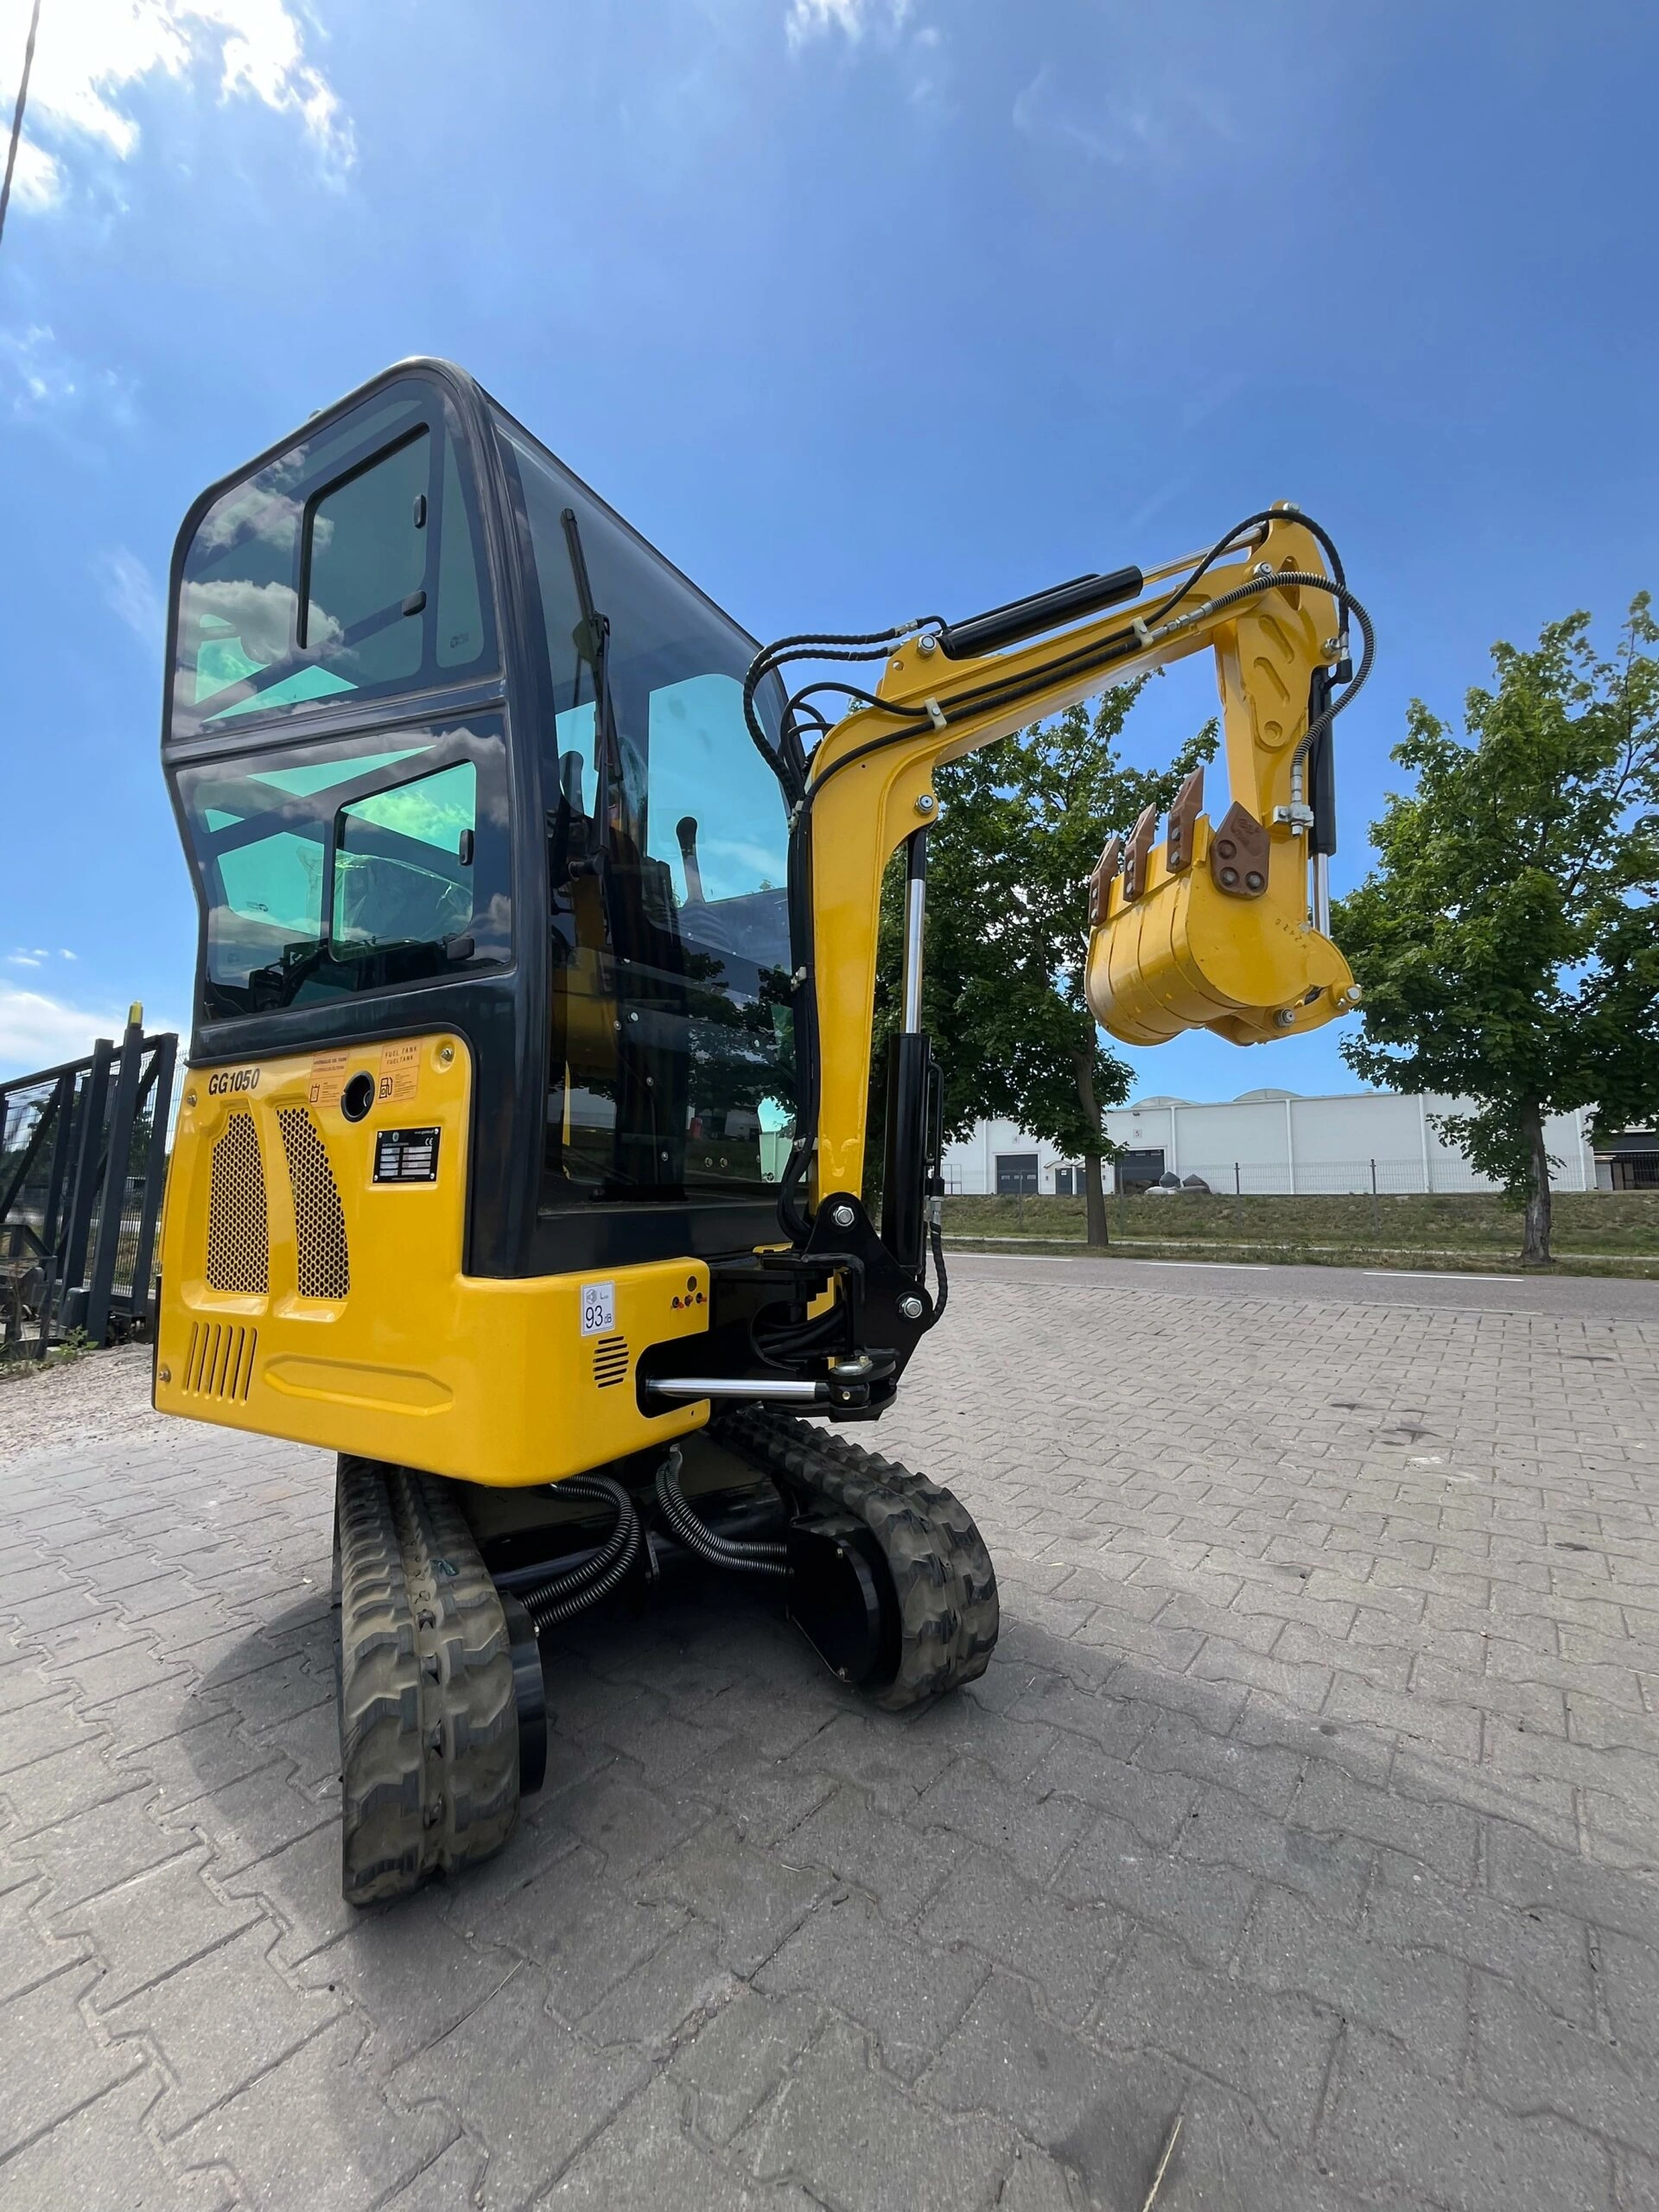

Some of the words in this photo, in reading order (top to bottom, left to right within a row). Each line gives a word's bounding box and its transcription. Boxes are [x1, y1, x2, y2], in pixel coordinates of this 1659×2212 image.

[402, 1046, 417, 1054] TANK
[208, 1068, 260, 1096] GG1050
[424, 1137, 434, 1146] CE
[585, 1305, 603, 1329] 93
[604, 1313, 612, 1324] dB
